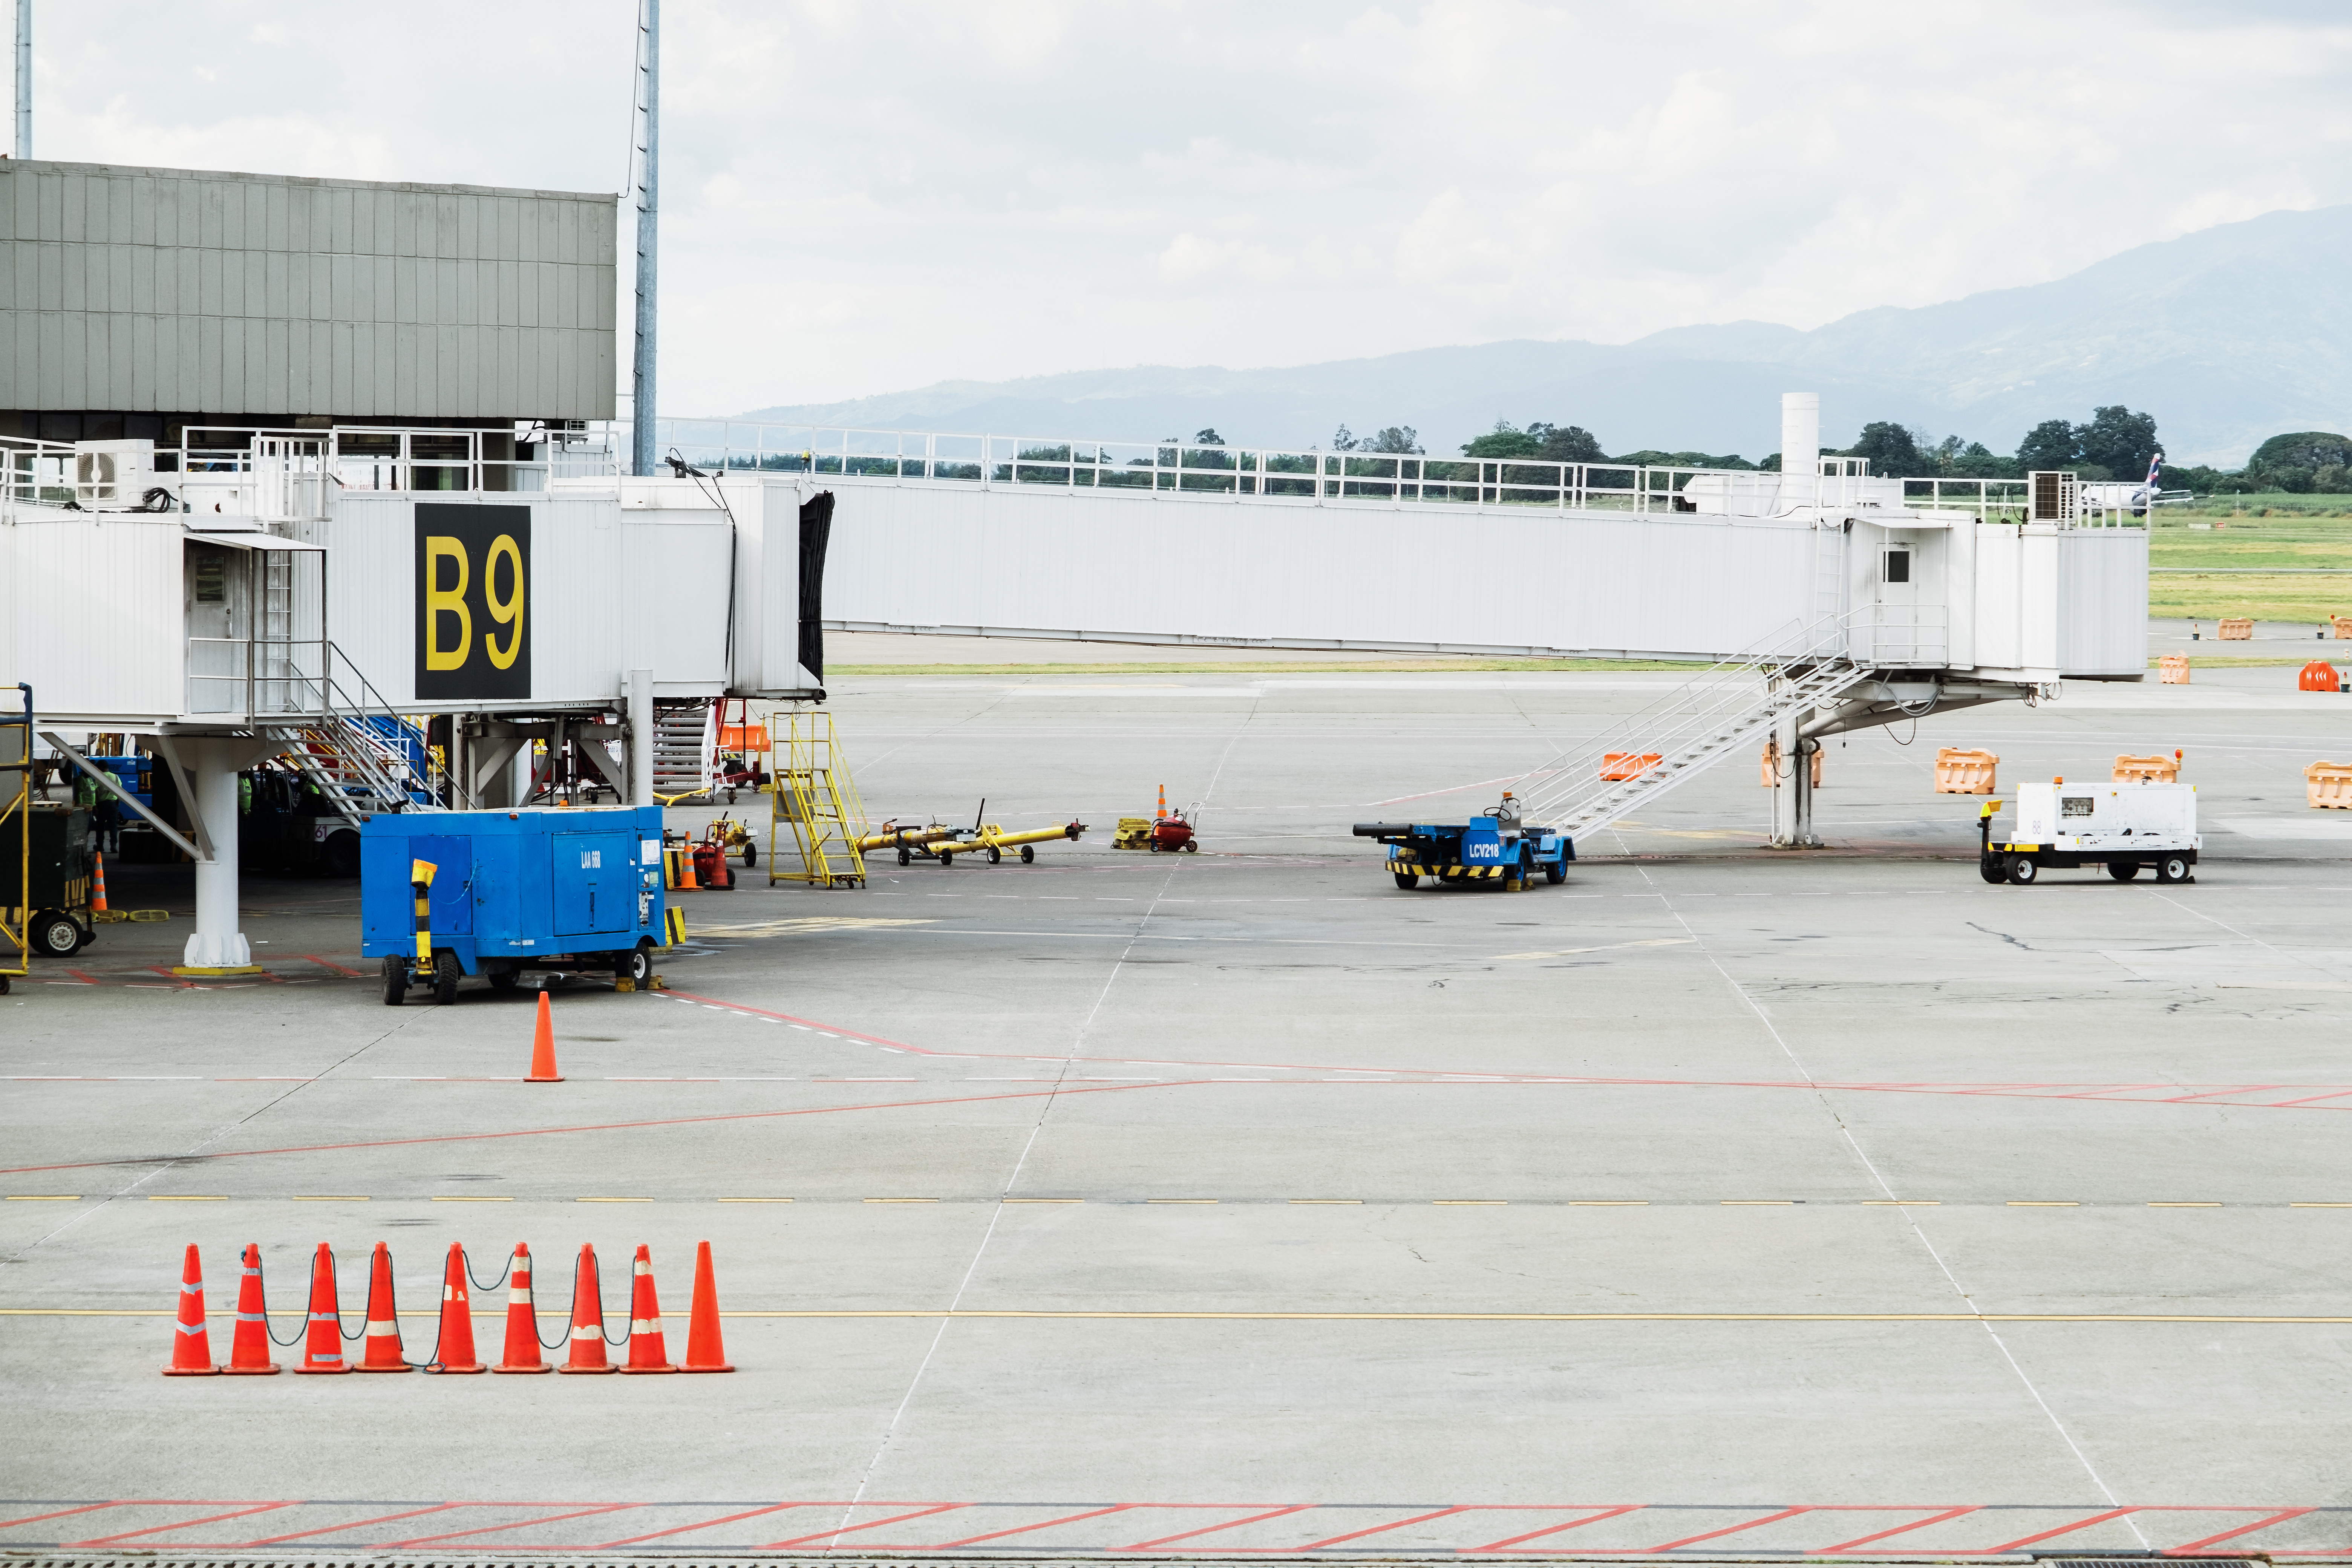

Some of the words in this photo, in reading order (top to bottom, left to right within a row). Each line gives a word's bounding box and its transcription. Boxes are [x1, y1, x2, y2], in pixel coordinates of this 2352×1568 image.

[426, 534, 524, 671] B9
[315, 825, 327, 839] 61
[2032, 820, 2041, 834] 88
[1469, 844, 1499, 858] LCV218
[581, 851, 591, 869] LAA
[592, 850, 600, 868] 668
